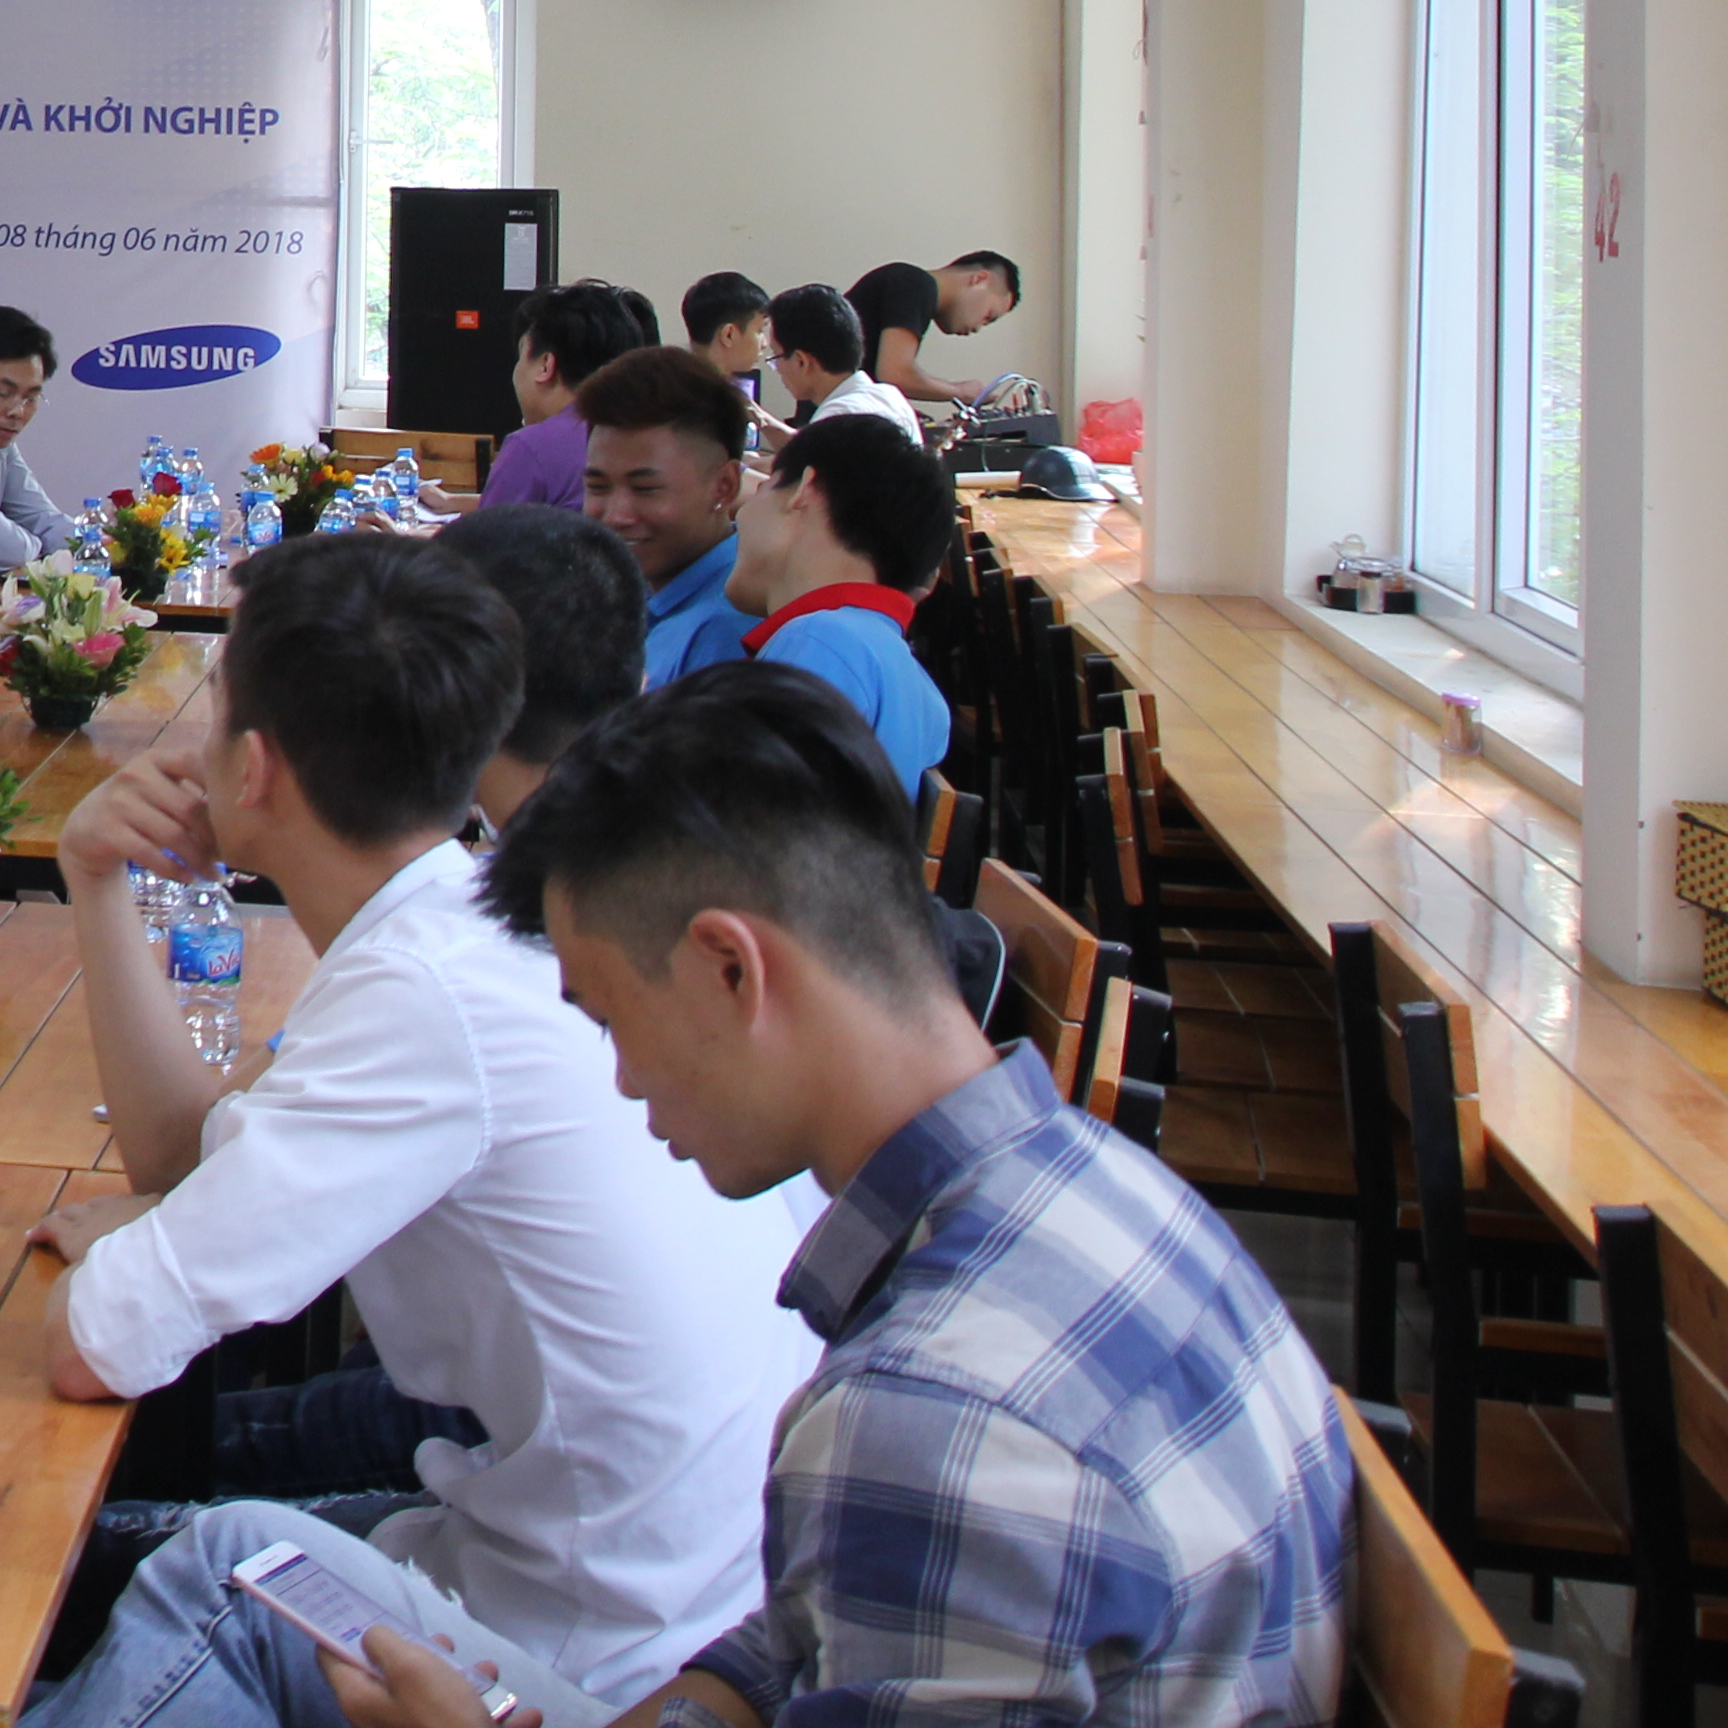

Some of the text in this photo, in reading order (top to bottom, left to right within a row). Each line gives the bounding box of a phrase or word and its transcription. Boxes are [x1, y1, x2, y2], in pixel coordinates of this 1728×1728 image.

[44, 96, 133, 134] KHỞI
[143, 102, 280, 144] NGHIỆP
[34, 223, 117, 256] tháng
[123, 228, 157, 252] 06
[163, 227, 228, 254] năm
[235, 230, 305, 255] 2018
[98, 342, 256, 372] SAMSUNG
